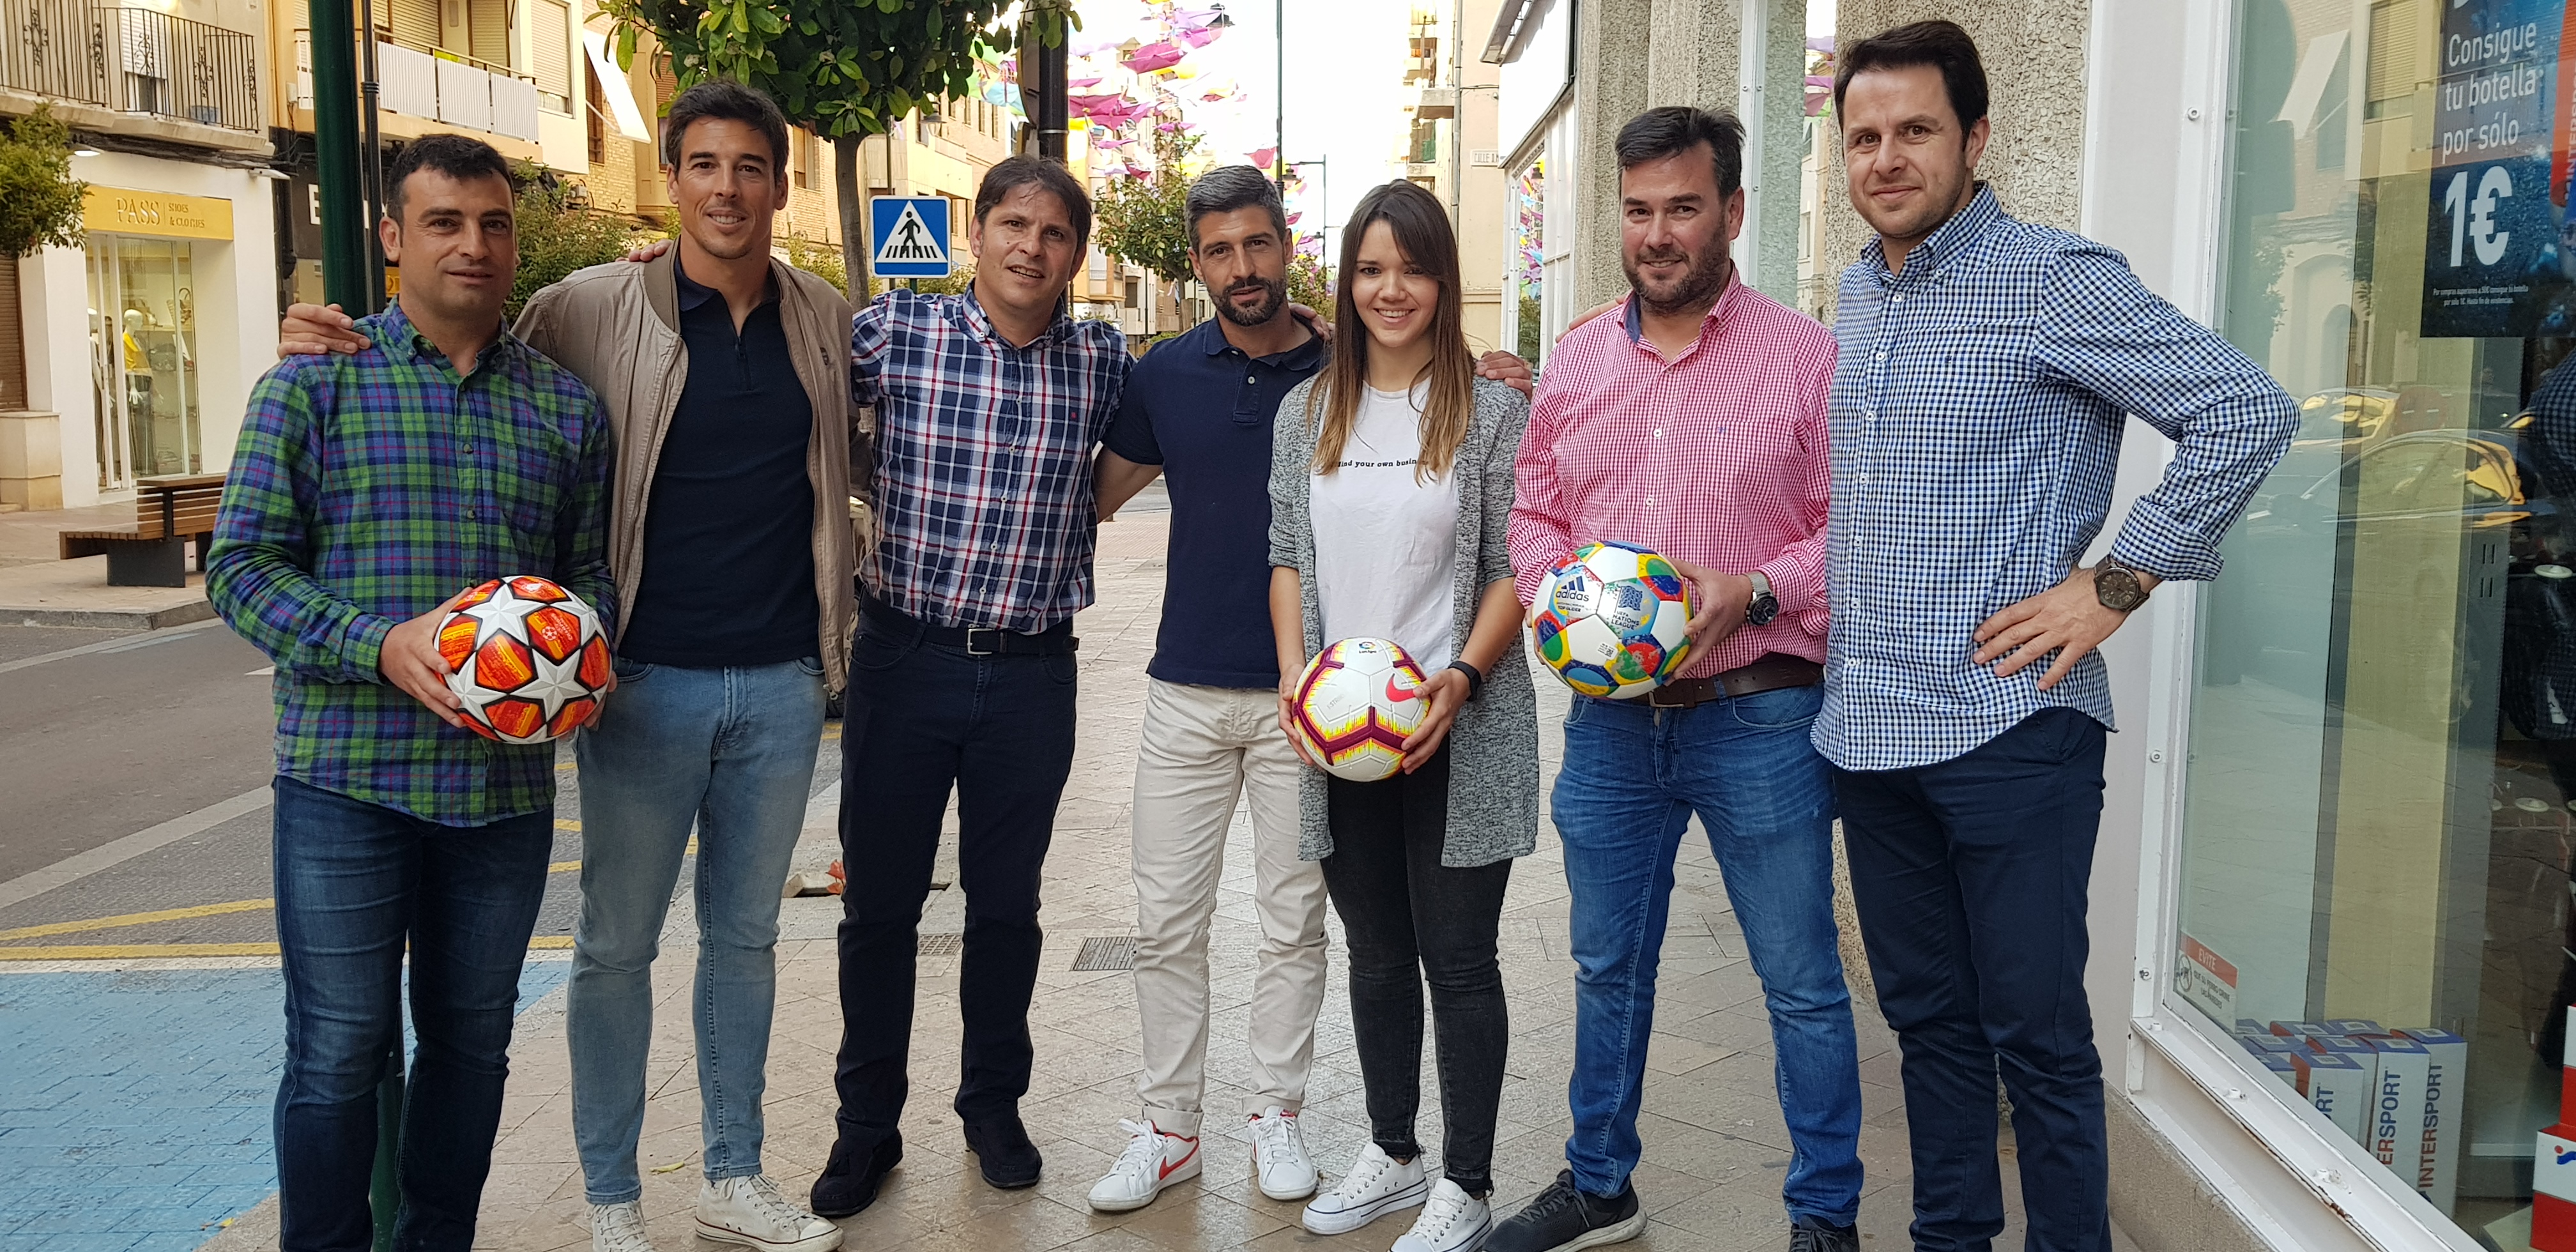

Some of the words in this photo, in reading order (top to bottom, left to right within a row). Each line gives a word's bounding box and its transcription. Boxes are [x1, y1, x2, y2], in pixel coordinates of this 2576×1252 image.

[2449, 22, 2536, 66] Consigue
[2446, 82, 2463, 111] tu
[2469, 63, 2536, 107] botella
[2442, 127, 2473, 164] por
[2478, 111, 2519, 149] sólo
[116, 197, 160, 225] PASS
[2445, 165, 2512, 267] 1€
[1397, 458, 1416, 466] busin
[1556, 590, 1590, 602] adidas
[1611, 619, 1634, 630] LEAGUE
[1613, 615, 1639, 625] NATIONS
[2418, 1065, 2442, 1187] INTERSPORT
